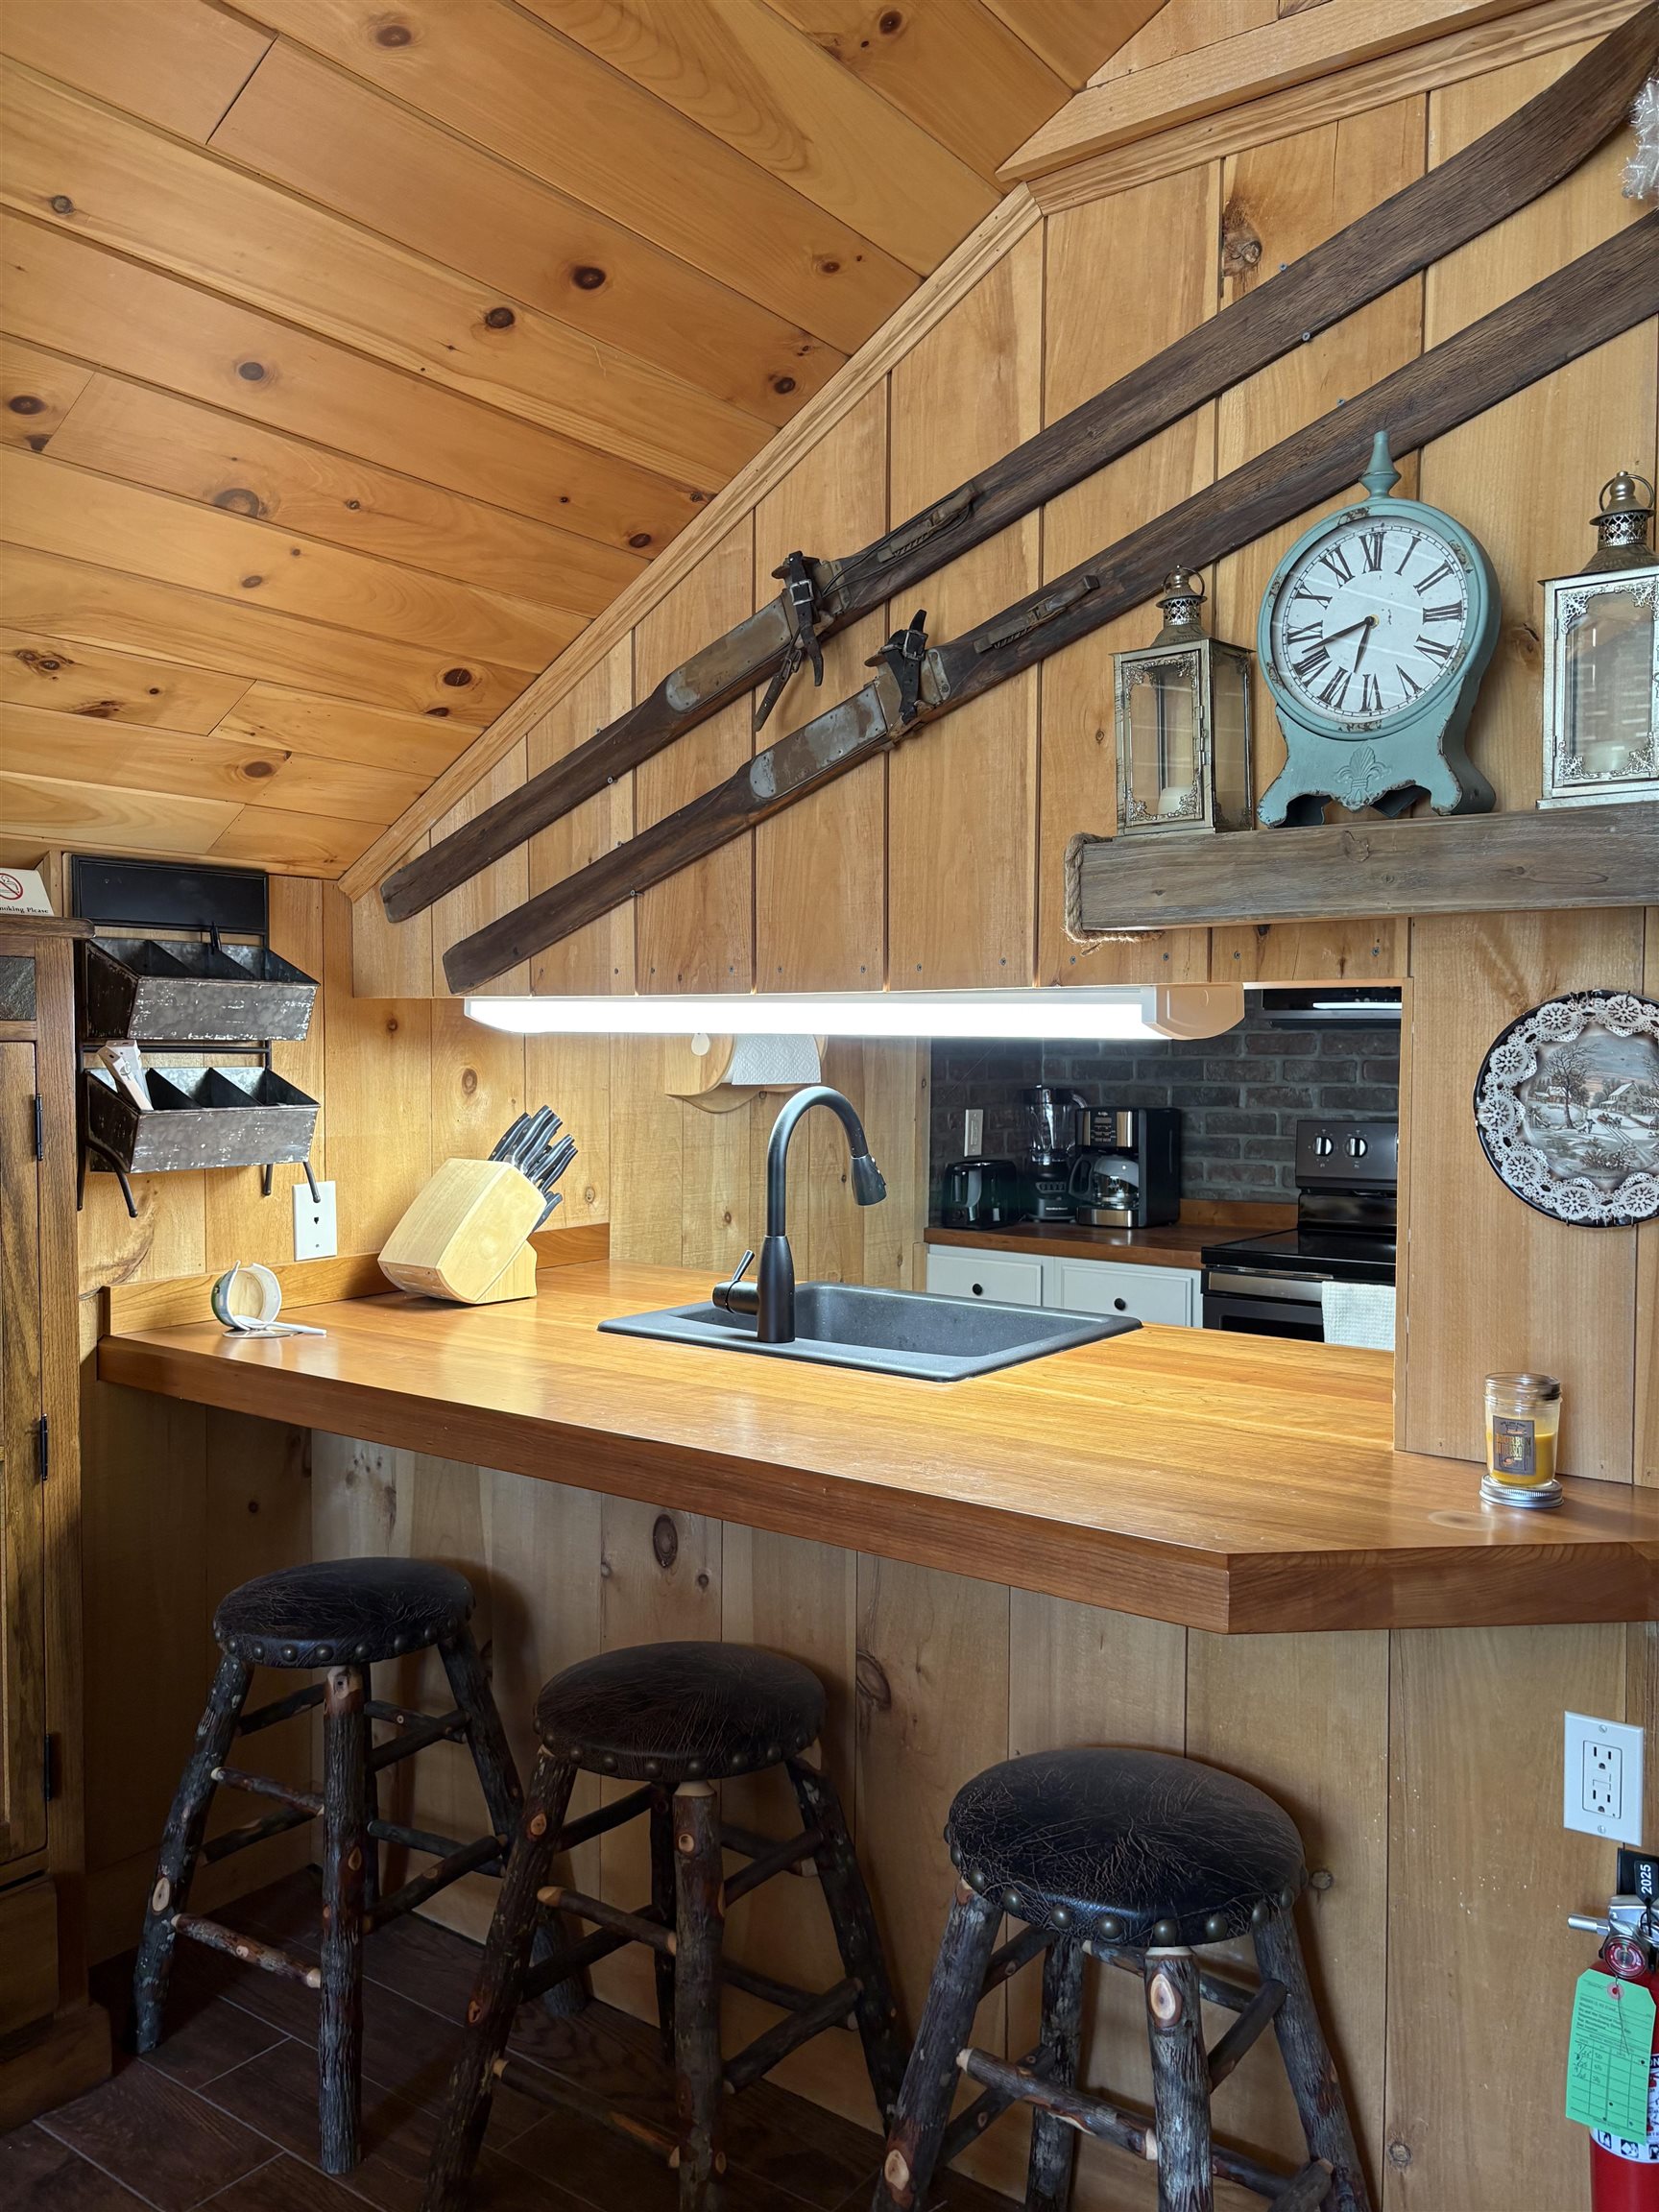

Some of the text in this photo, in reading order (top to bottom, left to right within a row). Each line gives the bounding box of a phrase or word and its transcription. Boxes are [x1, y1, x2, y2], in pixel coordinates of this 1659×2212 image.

[1319, 544, 1356, 589] XI
[1358, 531, 1386, 574] XII
[1394, 536, 1422, 576] I
[1294, 582, 1334, 610] X
[1413, 559, 1455, 596] II
[1422, 600, 1463, 625] III
[1287, 619, 1324, 646] IX
[1413, 634, 1455, 669] IV
[1292, 645, 1333, 688] VIII
[1395, 663, 1423, 701] V
[1316, 665, 1354, 709] VII
[1359, 673, 1383, 712] VI
[1640, 1863, 1652, 1895] 2025
